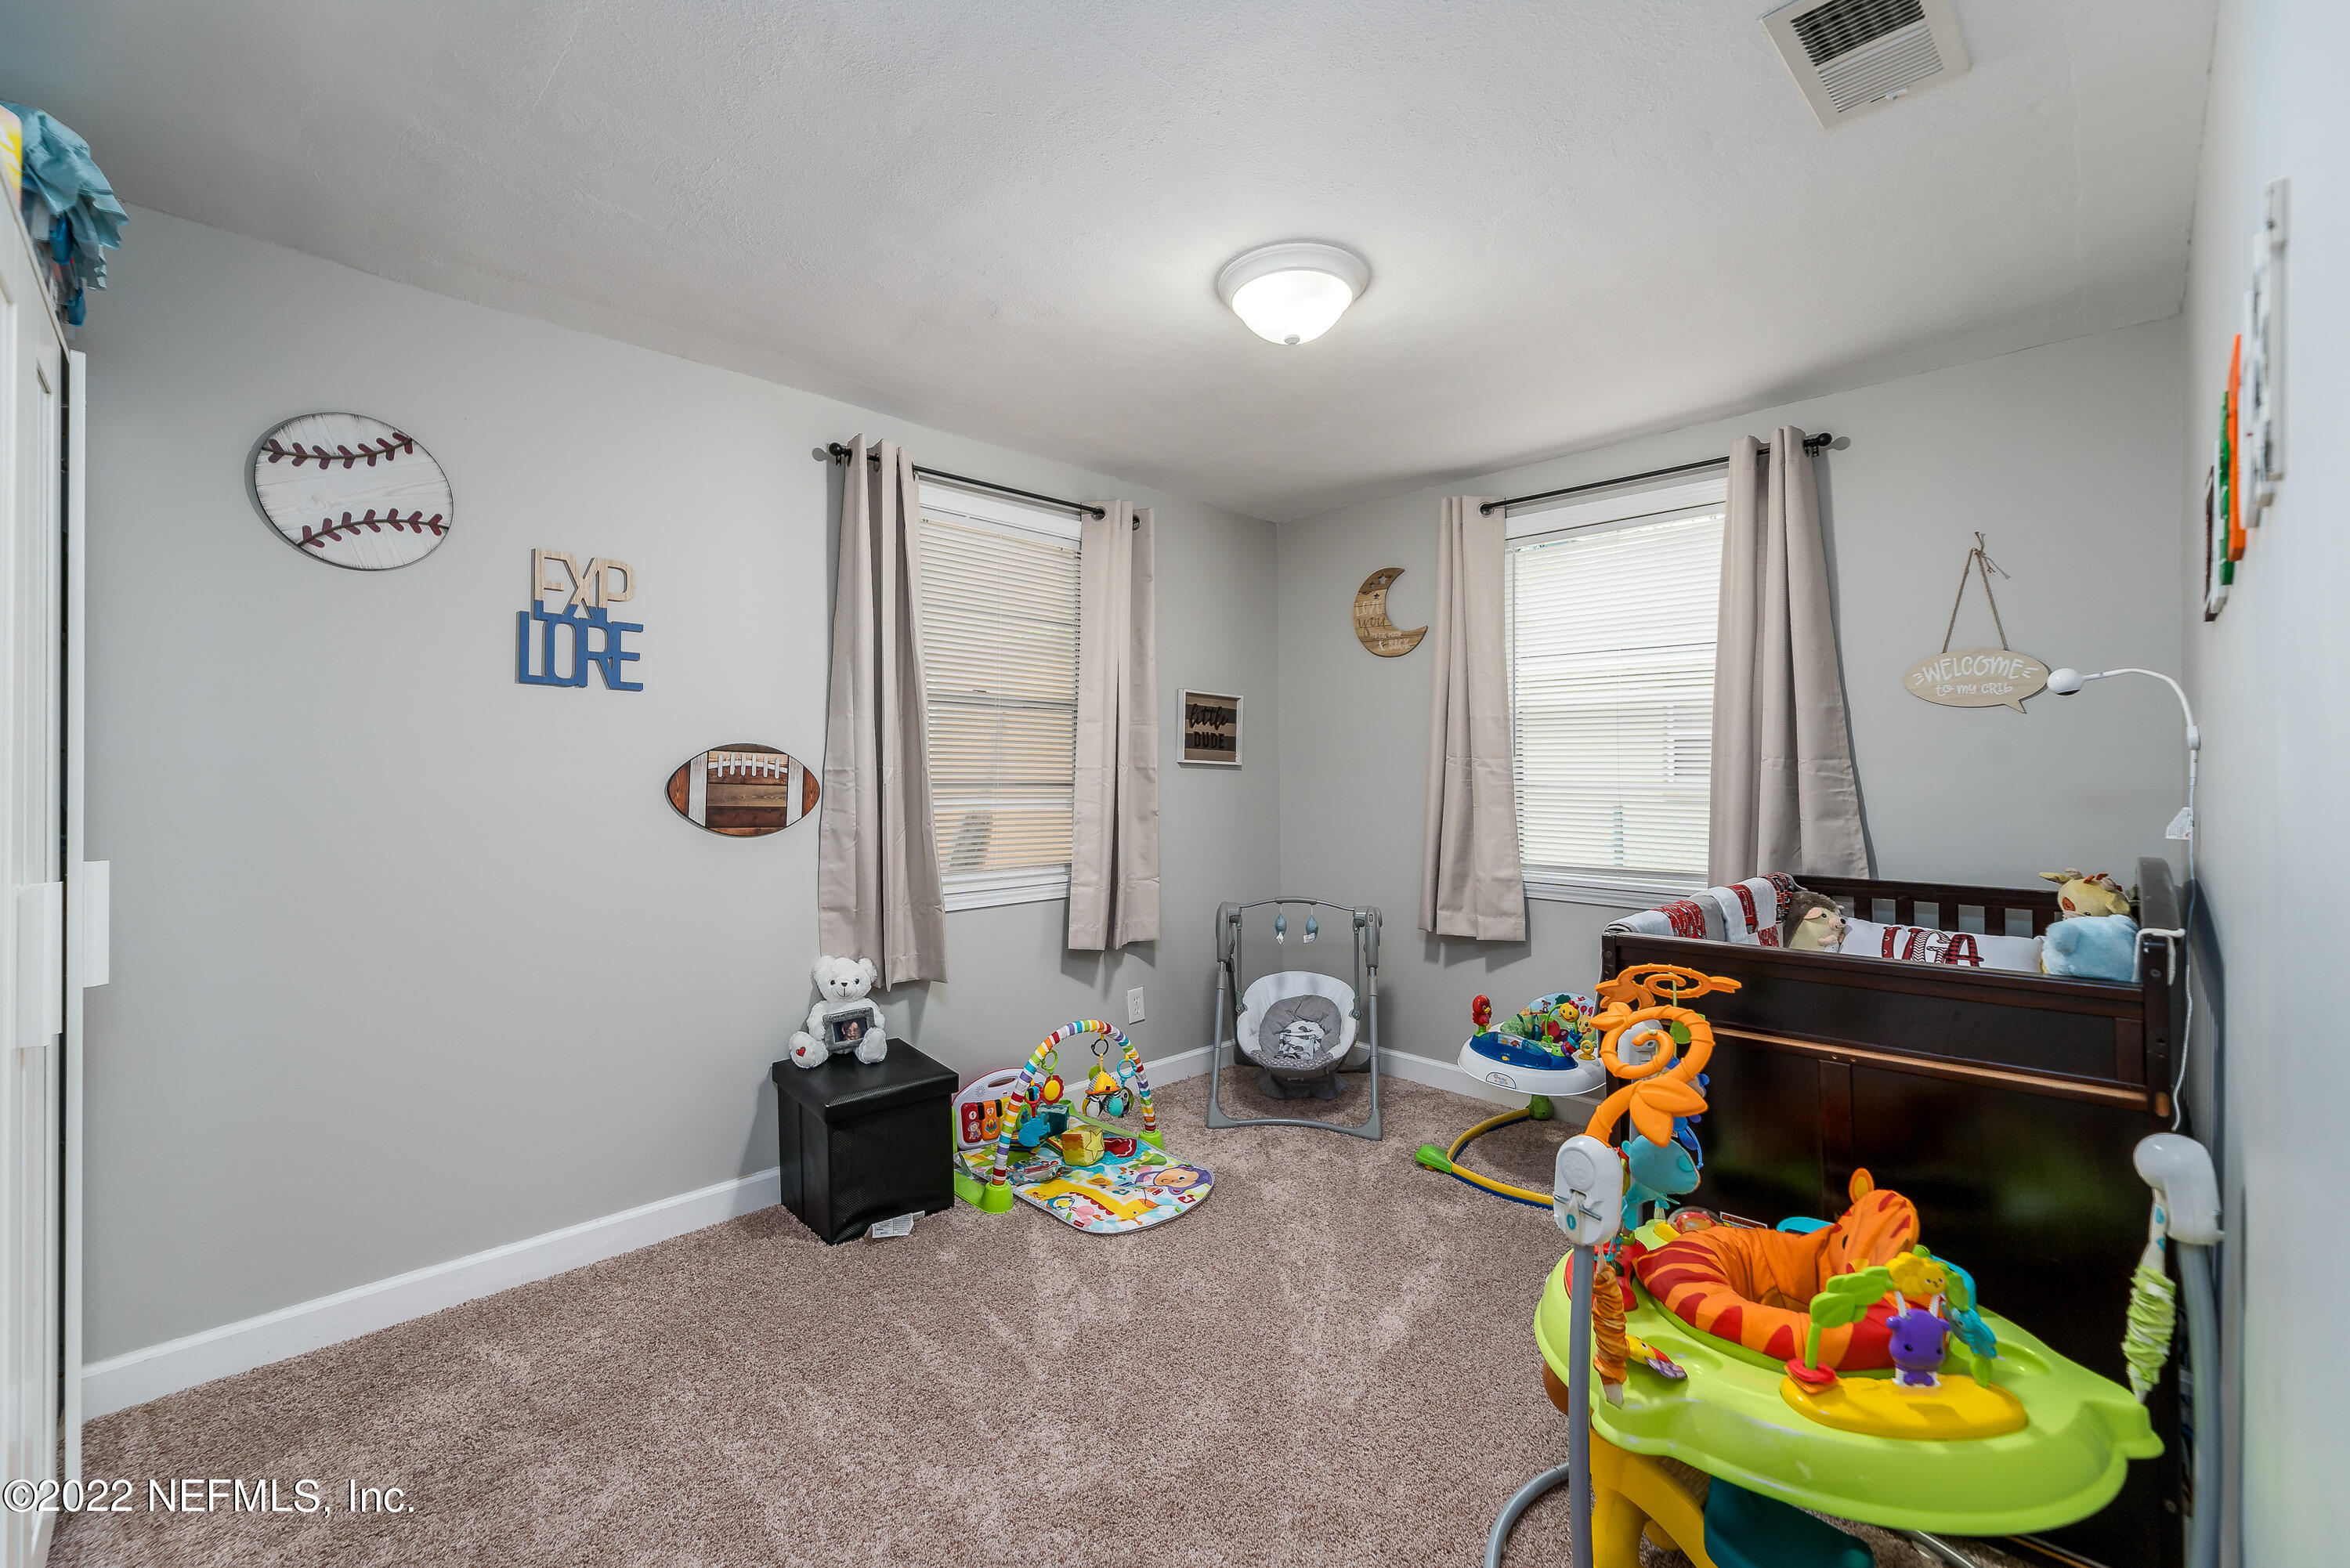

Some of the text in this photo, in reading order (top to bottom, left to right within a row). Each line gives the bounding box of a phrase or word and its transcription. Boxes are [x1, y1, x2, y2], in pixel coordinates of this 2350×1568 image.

[1357, 616, 1386, 638] you
[1922, 655, 2024, 683] WELCOME
[1935, 682, 1954, 697] to
[1956, 683, 1976, 695] my
[1188, 703, 1228, 731] little
[1193, 731, 1225, 749] DUDE
[1882, 926, 1984, 967] UGA
